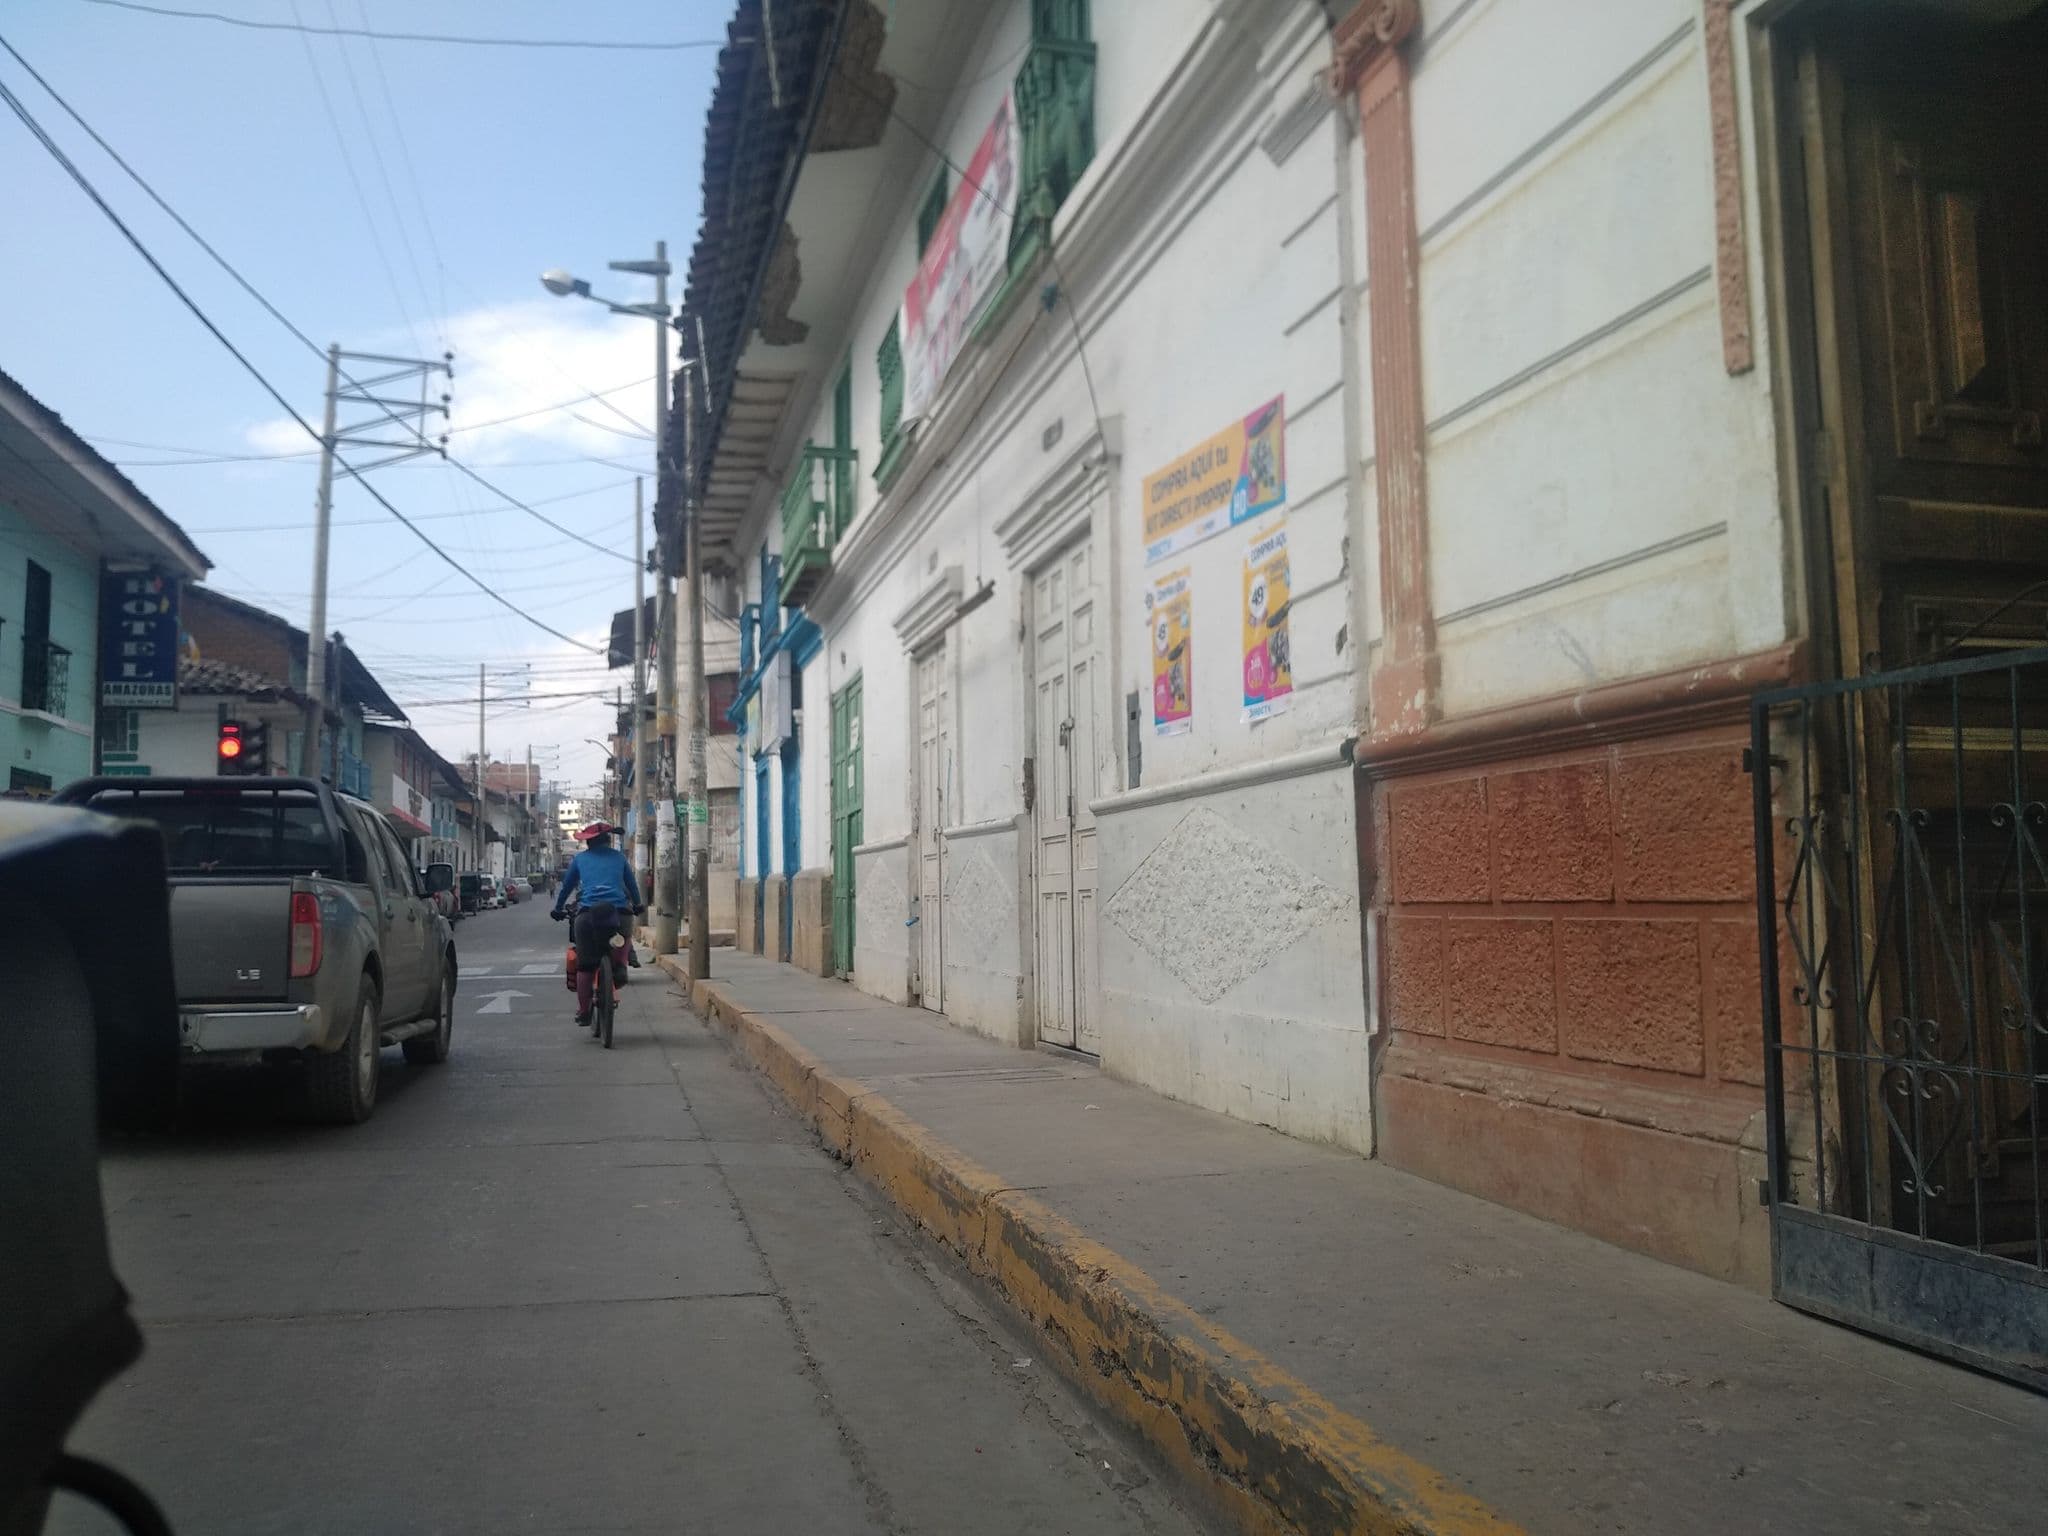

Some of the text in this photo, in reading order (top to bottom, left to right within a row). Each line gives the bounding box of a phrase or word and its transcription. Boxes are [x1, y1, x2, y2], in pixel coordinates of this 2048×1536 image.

[1151, 467, 1188, 504] COMPRA
[1233, 488, 1247, 520] HD
[122, 580, 157, 677] HOTEL
[103, 683, 172, 697] AMAZONAS
[237, 969, 260, 980] LE
